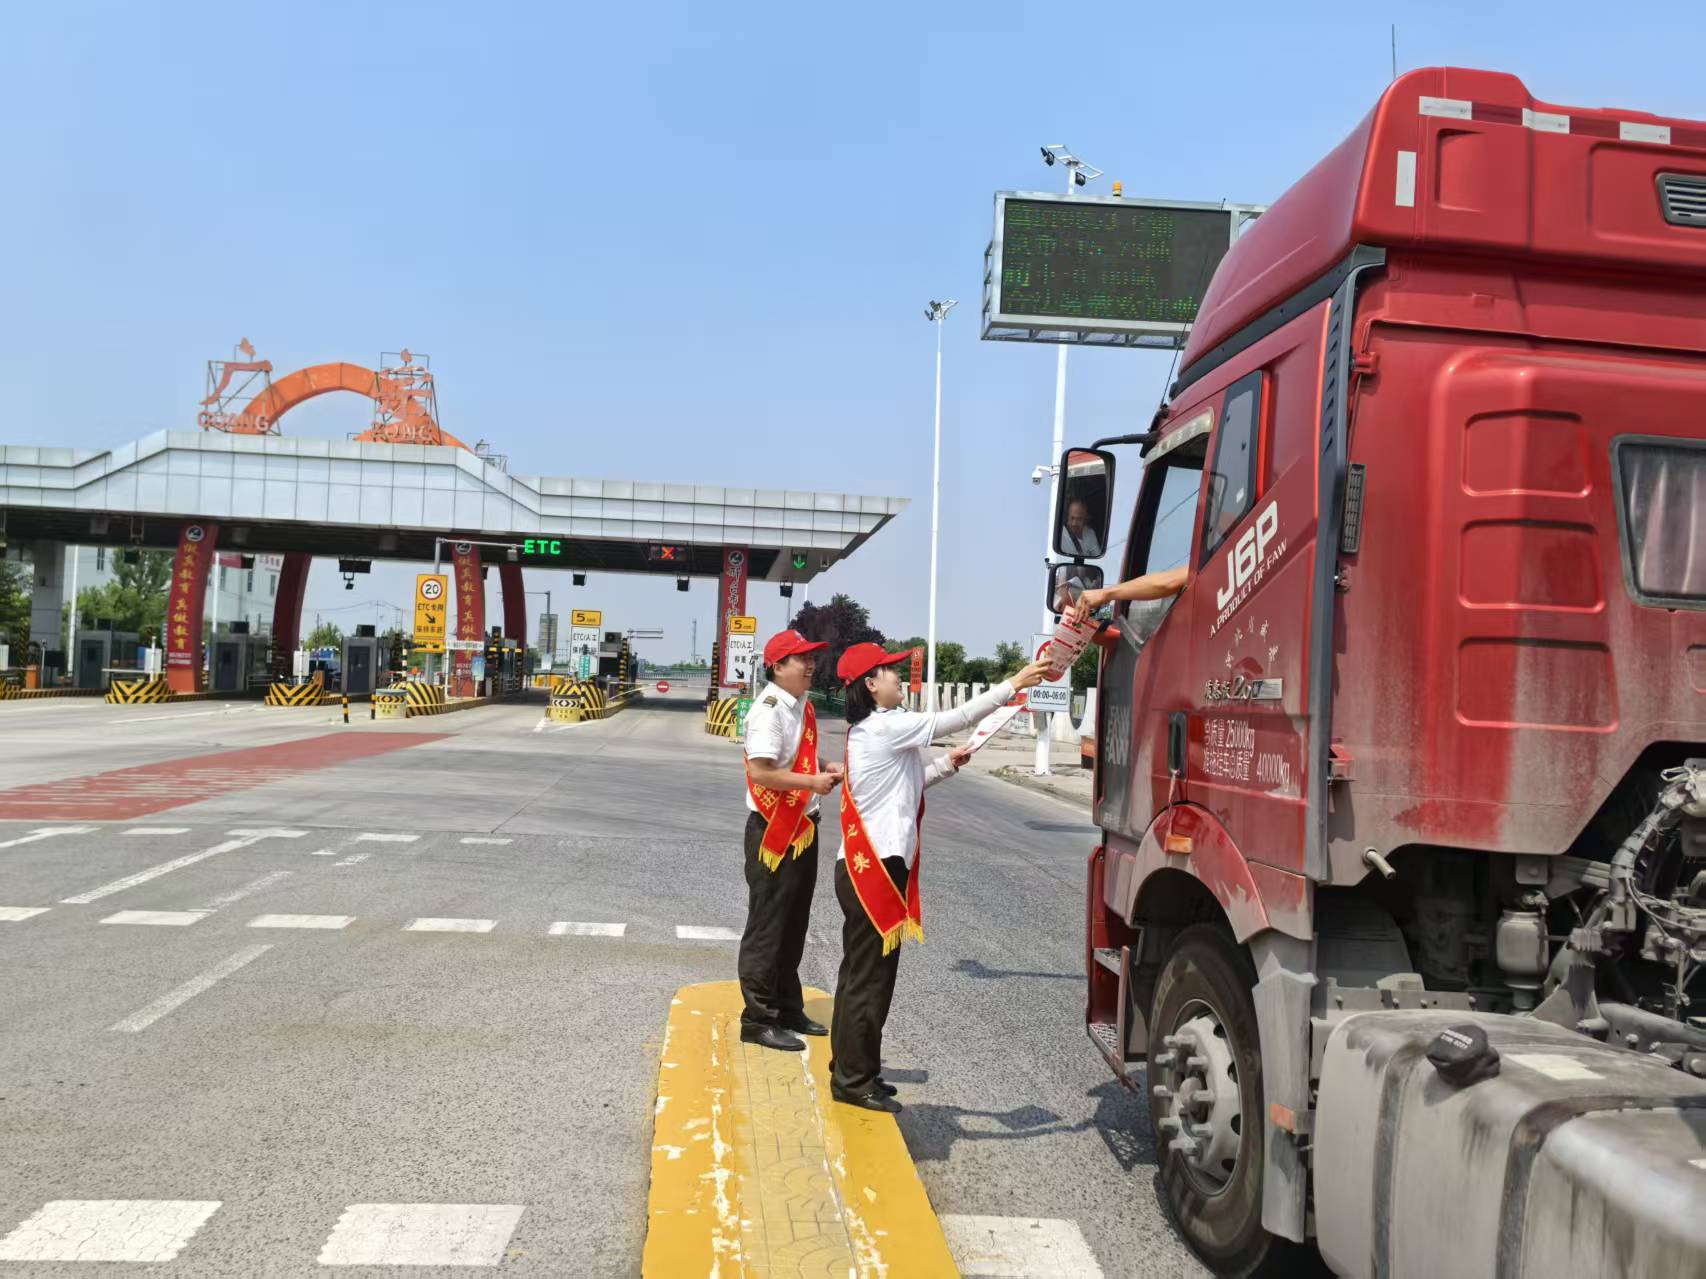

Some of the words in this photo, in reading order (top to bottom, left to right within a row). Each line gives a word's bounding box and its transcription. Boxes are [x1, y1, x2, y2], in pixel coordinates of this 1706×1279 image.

[524, 539, 561, 554] ETC
[1217, 500, 1278, 611] J6P
[425, 584, 439, 594] 20
[1217, 580, 1252, 629] PRODUCT
[1254, 563, 1266, 585] OF
[1266, 537, 1287, 570] FAW
